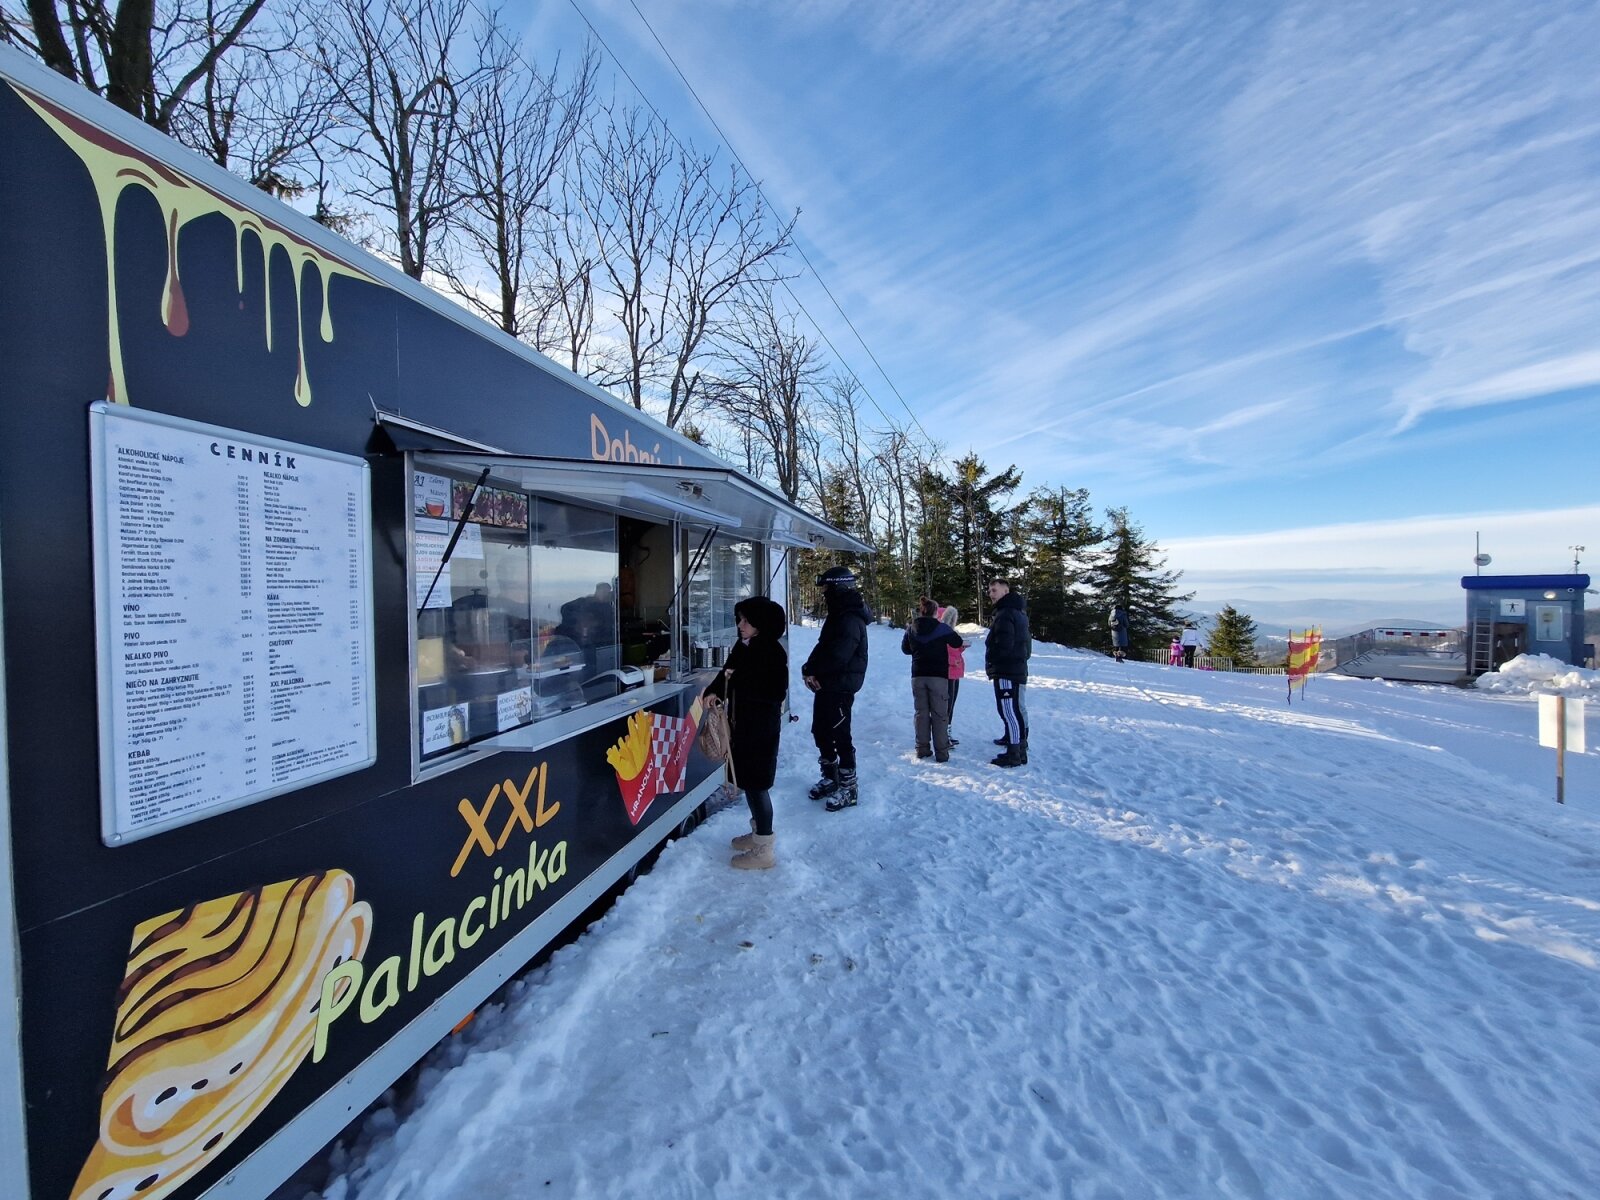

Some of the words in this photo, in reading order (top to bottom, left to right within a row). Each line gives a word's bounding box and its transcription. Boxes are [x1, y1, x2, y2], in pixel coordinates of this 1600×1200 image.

[118, 448, 159, 460] ALKOHOLICKÉ
[162, 454, 184, 464] NÁPOJE
[210, 442, 296, 469] CENNÍK
[264, 471, 281, 480] NEALKO
[282, 474, 299, 482] NÁPOJE
[125, 652, 151, 660] NEALKO
[154, 650, 168, 658] PIVO
[126, 680, 147, 689] NIEČO
[161, 674, 200, 685] ZAHRYZNUTIE
[128, 749, 150, 759] KEBAB
[630, 758, 654, 816] HRANOLKY
[450, 762, 560, 878] XXL
[312, 840, 567, 1064] Palacinka
